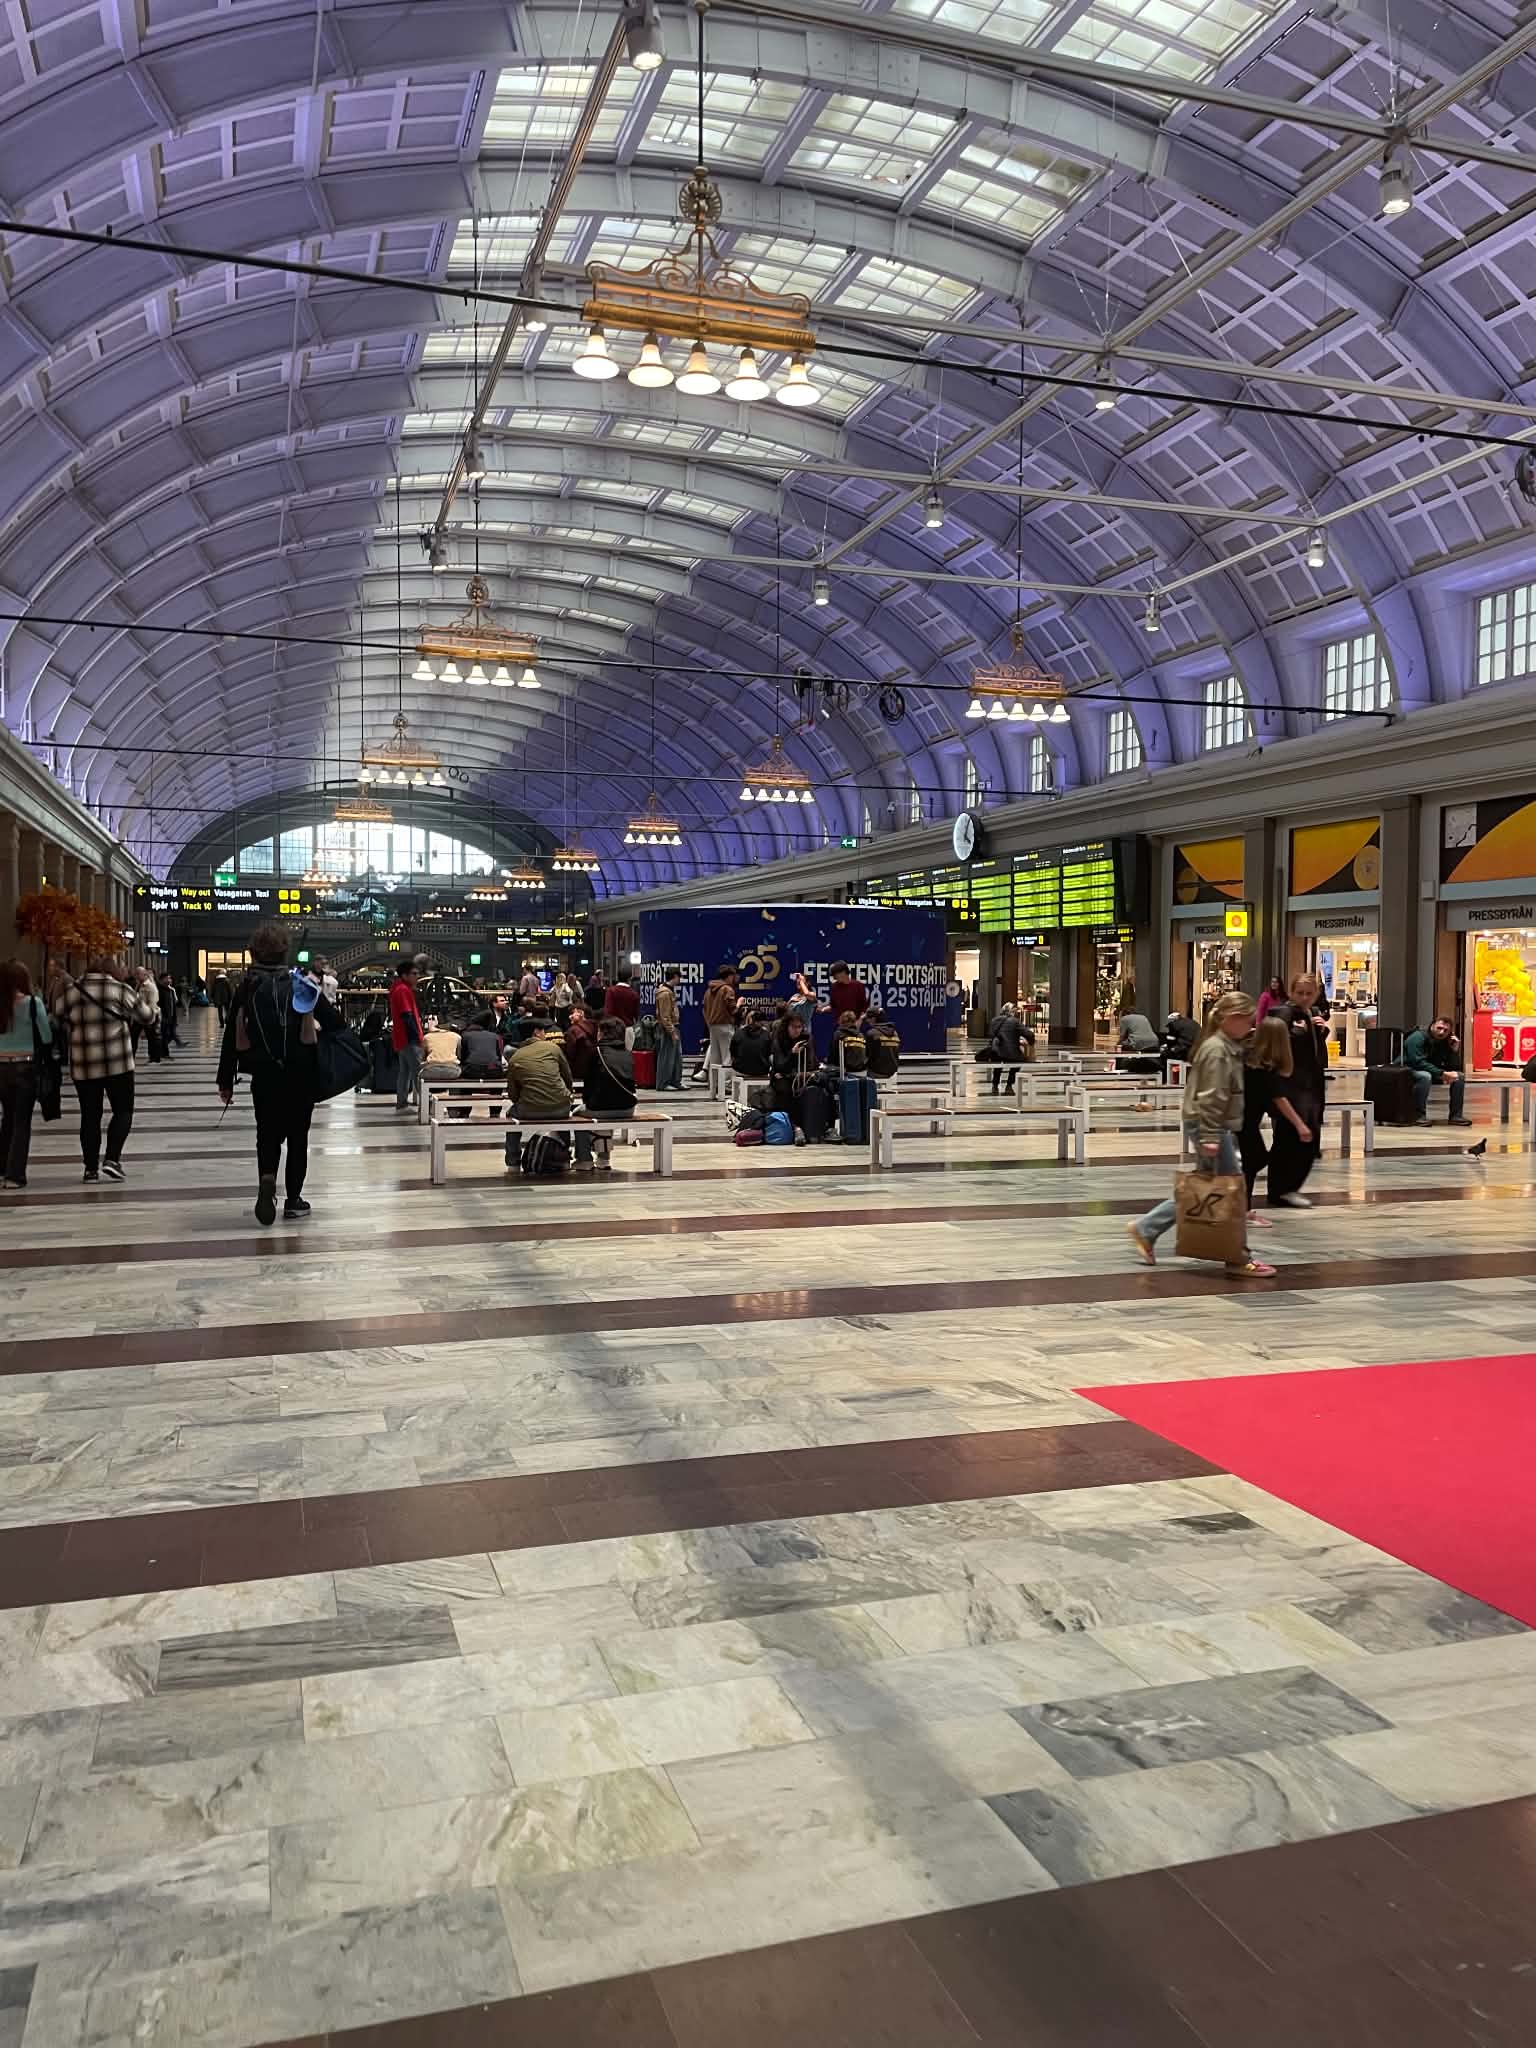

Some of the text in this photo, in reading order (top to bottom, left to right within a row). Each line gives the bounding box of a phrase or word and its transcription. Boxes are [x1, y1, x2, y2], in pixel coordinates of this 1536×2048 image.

[150, 887, 270, 899] Utgång Way out Vasagatan Taxi
[151, 901, 168, 910] Spår
[170, 901, 179, 910] 10
[182, 901, 201, 910] Track
[217, 902, 260, 911] Information
[1469, 905, 1533, 921] PRESSBYRÅN
[1315, 915, 1364, 928] PRESSBYRÅN
[886, 987, 907, 1008] 25
